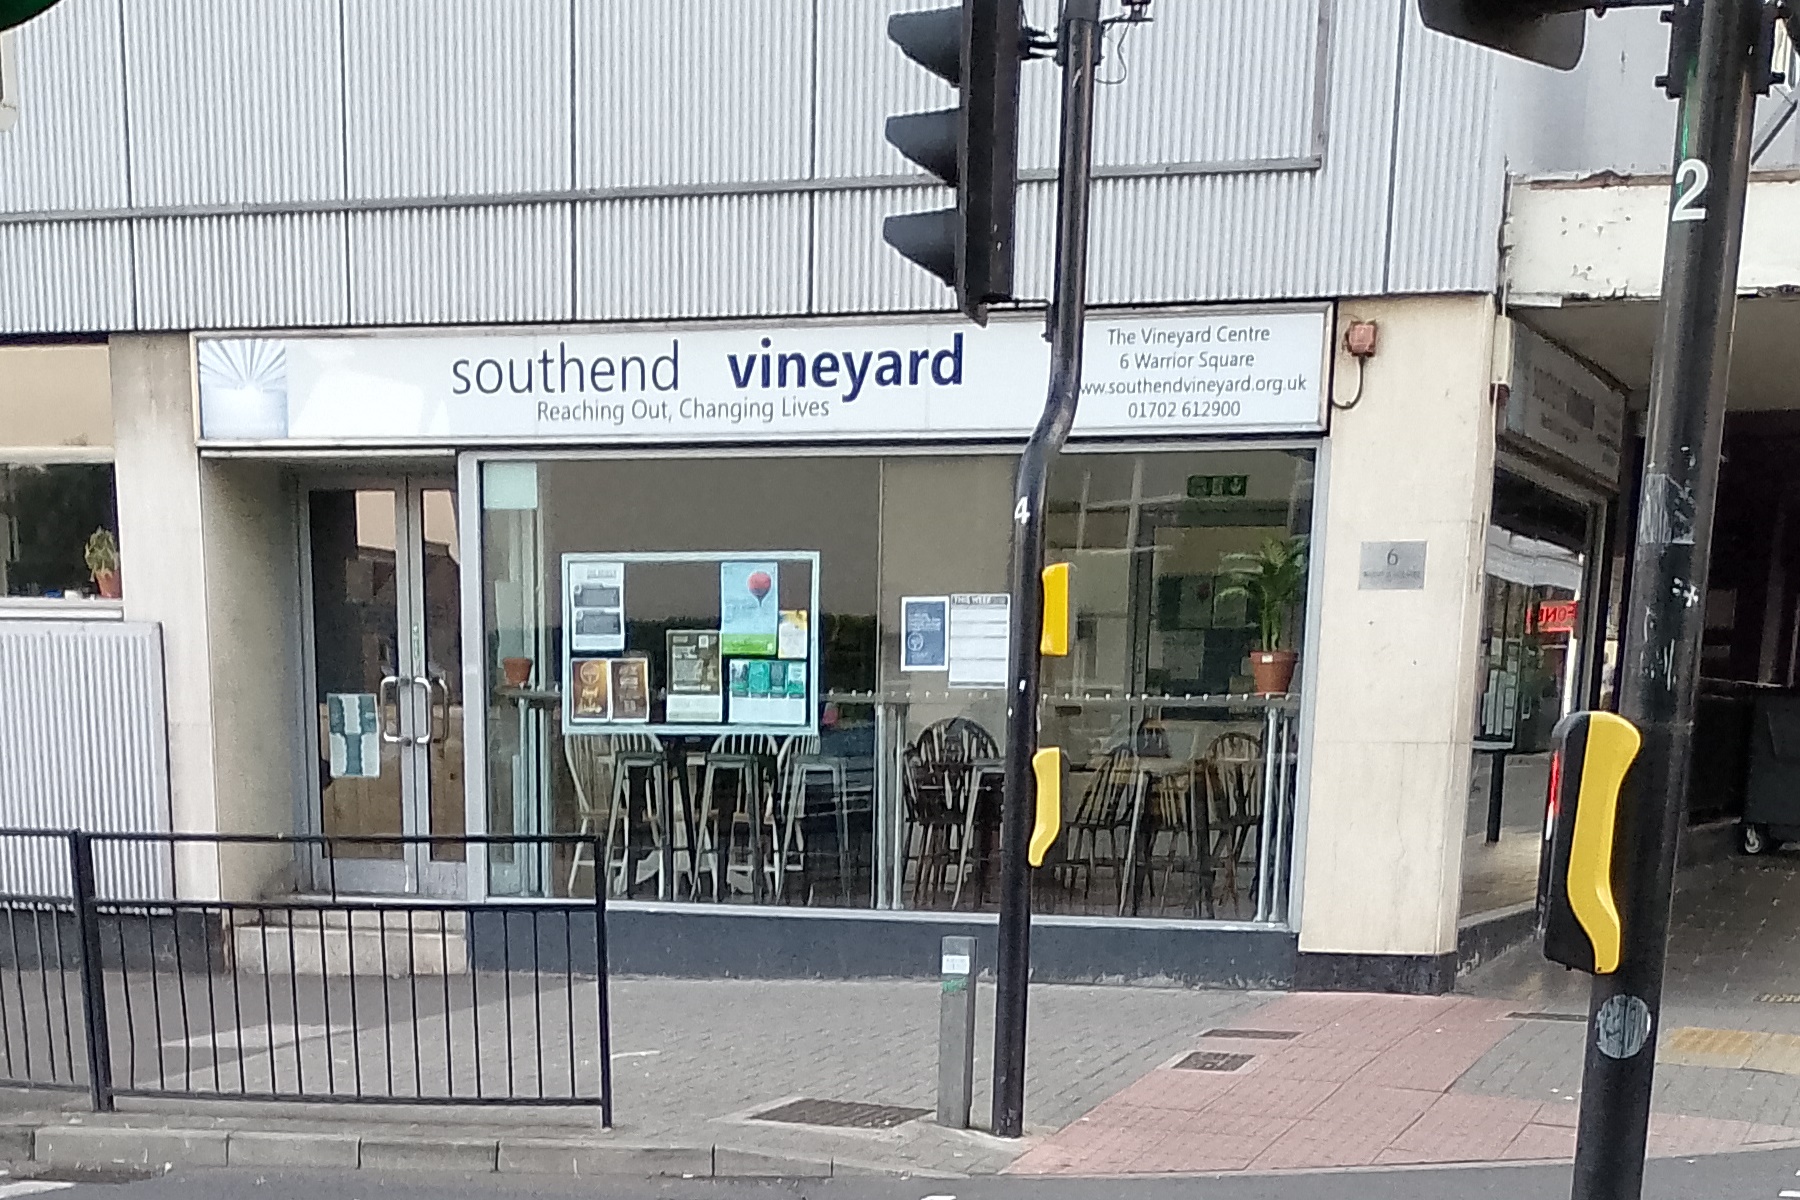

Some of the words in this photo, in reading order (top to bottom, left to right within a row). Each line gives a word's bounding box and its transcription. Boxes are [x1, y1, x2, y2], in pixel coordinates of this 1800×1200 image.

[1672, 158, 1709, 222] 2
[1107, 328, 1136, 345] The
[1140, 325, 1212, 348] Vineyard
[1216, 325, 1271, 342] Centre
[452, 338, 679, 395] southend
[727, 331, 964, 403] vineyard
[1120, 353, 1129, 370] 6
[1135, 351, 1194, 370] Warrior
[1198, 350, 1255, 373] Square
[1081, 373, 1307, 396] ww.southendvineyard.org.uk
[537, 399, 624, 426] Reaching
[631, 399, 672, 423] Out,
[679, 397, 774, 424] Changing
[782, 396, 830, 418] Lives
[1128, 402, 1177, 418] 01702
[1181, 400, 1241, 418] 612900
[1014, 495, 1030, 525] 4
[1387, 548, 1399, 566] 6
